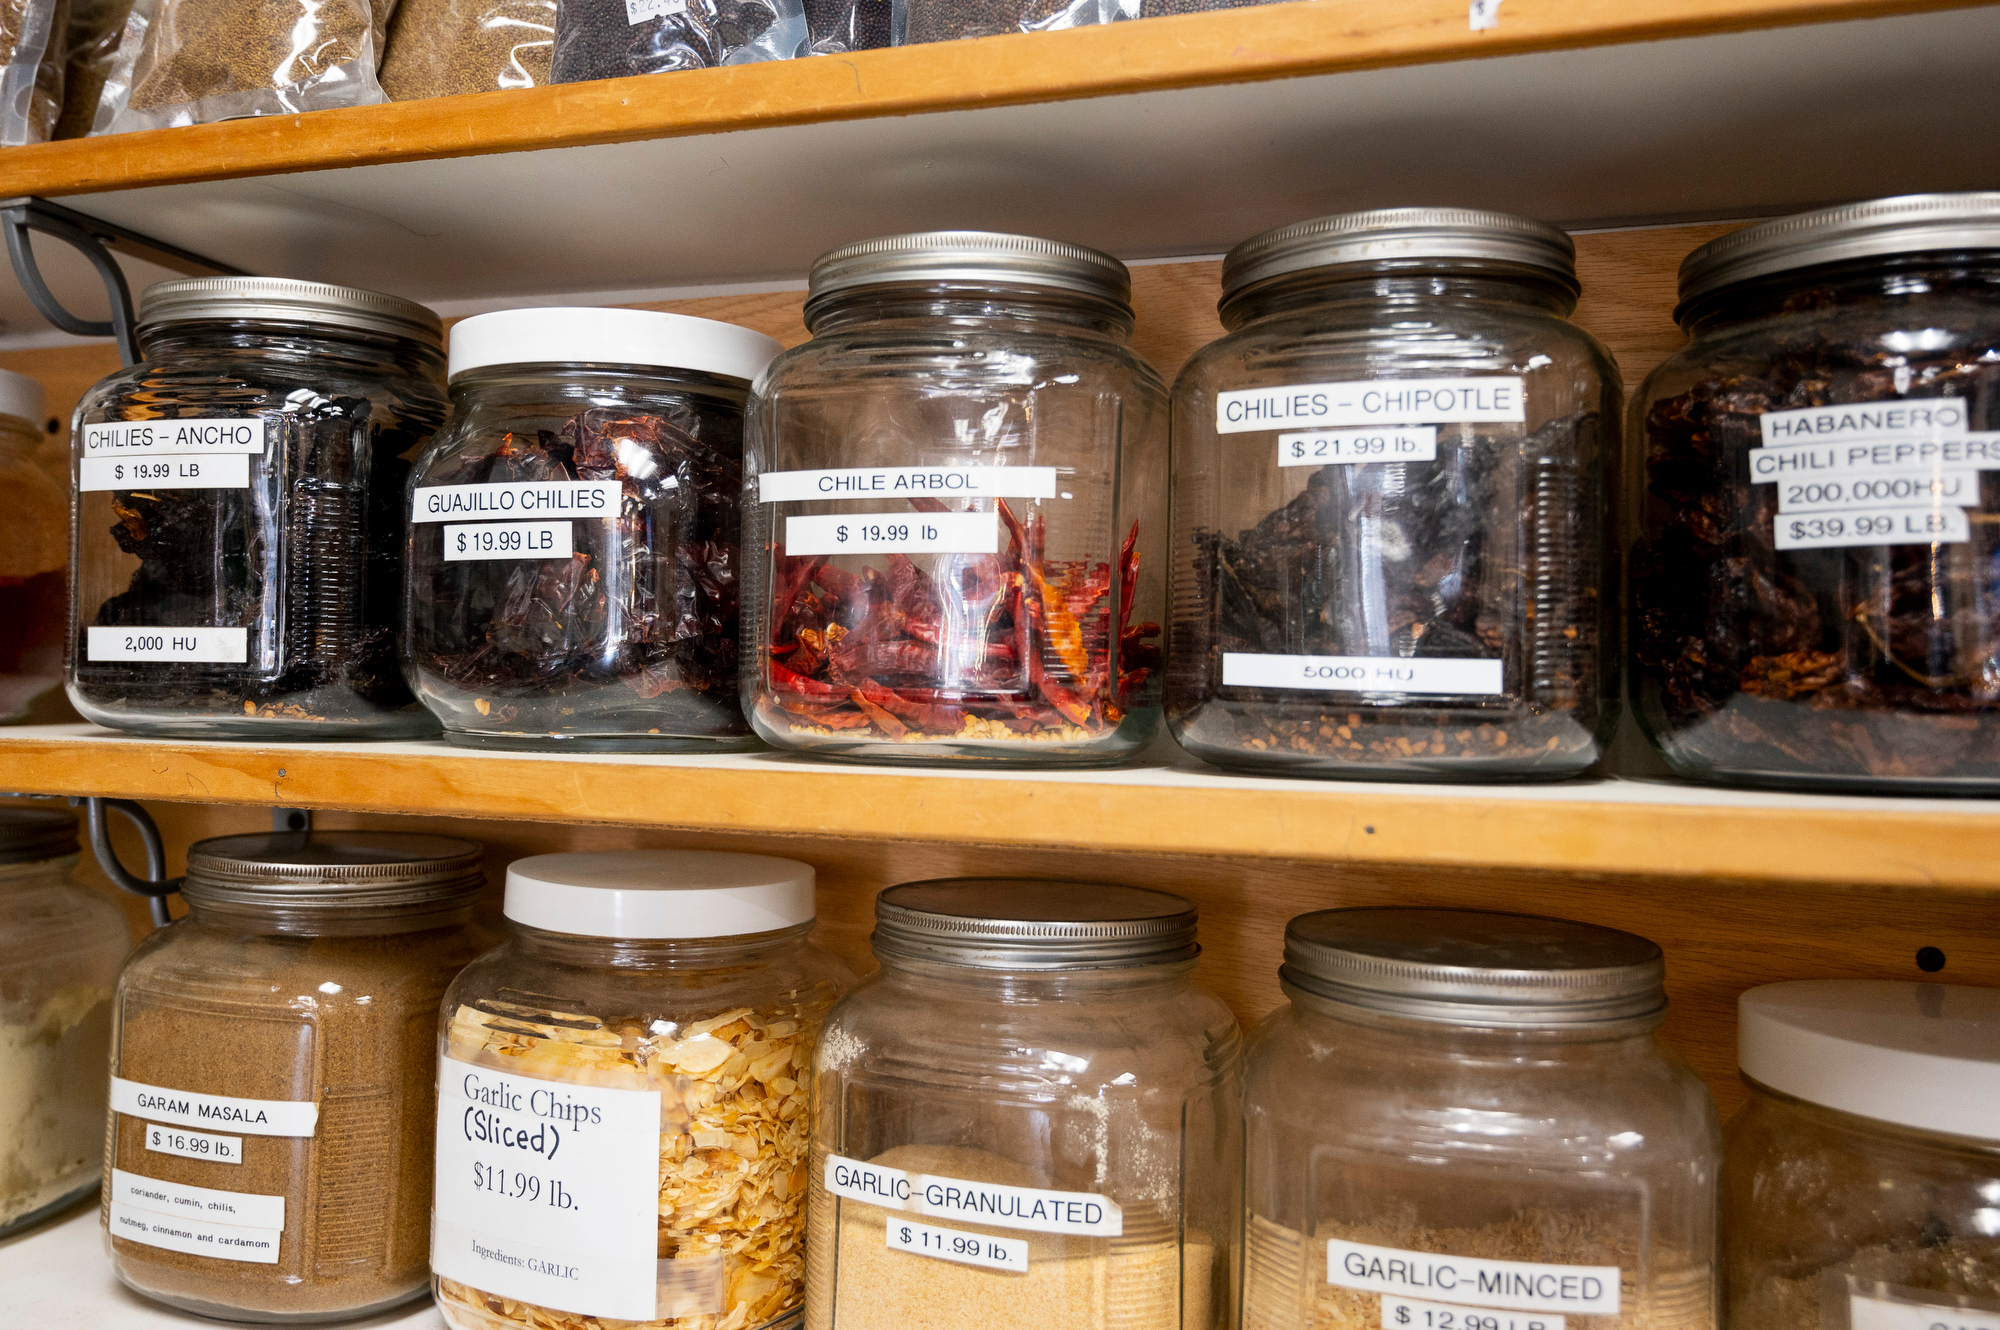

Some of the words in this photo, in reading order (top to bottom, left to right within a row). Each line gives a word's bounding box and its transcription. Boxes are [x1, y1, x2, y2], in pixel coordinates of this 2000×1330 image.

[1226, 393, 1329, 422] CHILIES
[1362, 387, 1511, 414] CHIPOTLE
[1772, 406, 1960, 438] HABANERO
[89, 428, 153, 449] CHILIES
[175, 426, 252, 445] ANCHO
[1291, 440, 1306, 458] $
[1314, 437, 1385, 457] 21.99
[1395, 436, 1423, 453] lb.
[115, 464, 124, 480] $
[133, 463, 170, 478] 19.99
[179, 463, 200, 477] LB
[1756, 449, 1834, 475] CHILI
[818, 475, 886, 492] CHILE
[894, 473, 979, 490] ARBOL
[428, 490, 515, 513] GUAJILLO
[521, 489, 606, 510] CHILIES
[836, 525, 848, 543] $
[861, 525, 909, 541] 19.99
[921, 525, 938, 540] lb
[1789, 516, 1893, 541] $39.99
[1905, 515, 1955, 534] LB.
[457, 532, 467, 553] $
[473, 531, 521, 551] 19.99
[528, 530, 553, 550] LB
[125, 636, 163, 653] 2,000
[172, 637, 197, 651] HU
[1303, 665, 1366, 680] 5000
[1376, 668, 1414, 681] HU
[137, 1093, 190, 1115] GARAM
[198, 1103, 268, 1124] MASALA
[464, 1073, 522, 1112] Garlic
[530, 1089, 602, 1132] Chips
[152, 1131, 161, 1146] $
[167, 1134, 210, 1154] 16.99
[215, 1141, 235, 1157] lb.
[464, 1106, 560, 1160] (Sliced)
[473, 1160, 541, 1202] $11.99
[549, 1179, 579, 1211] lb.
[834, 1165, 1103, 1225] GARLIC-GRANULATED
[130, 1186, 169, 1203] coriander,
[174, 1195, 203, 1210] cumin,
[208, 1202, 236, 1214] chilis,
[119, 1215, 149, 1231] nutmeg,
[152, 1224, 193, 1239] cinnamon
[197, 1233, 213, 1243] and
[218, 1235, 270, 1249] cardamom
[900, 1227, 912, 1244] $
[921, 1231, 980, 1257] 11.99
[988, 1243, 1013, 1262] lb.
[472, 1239, 525, 1268] Ingredients:
[527, 1257, 579, 1281] GARLIC
[1344, 1252, 1603, 1301] GARLIC-MINCED
[1395, 1305, 1411, 1324] $
[1424, 1310, 1498, 1330] 12.99
